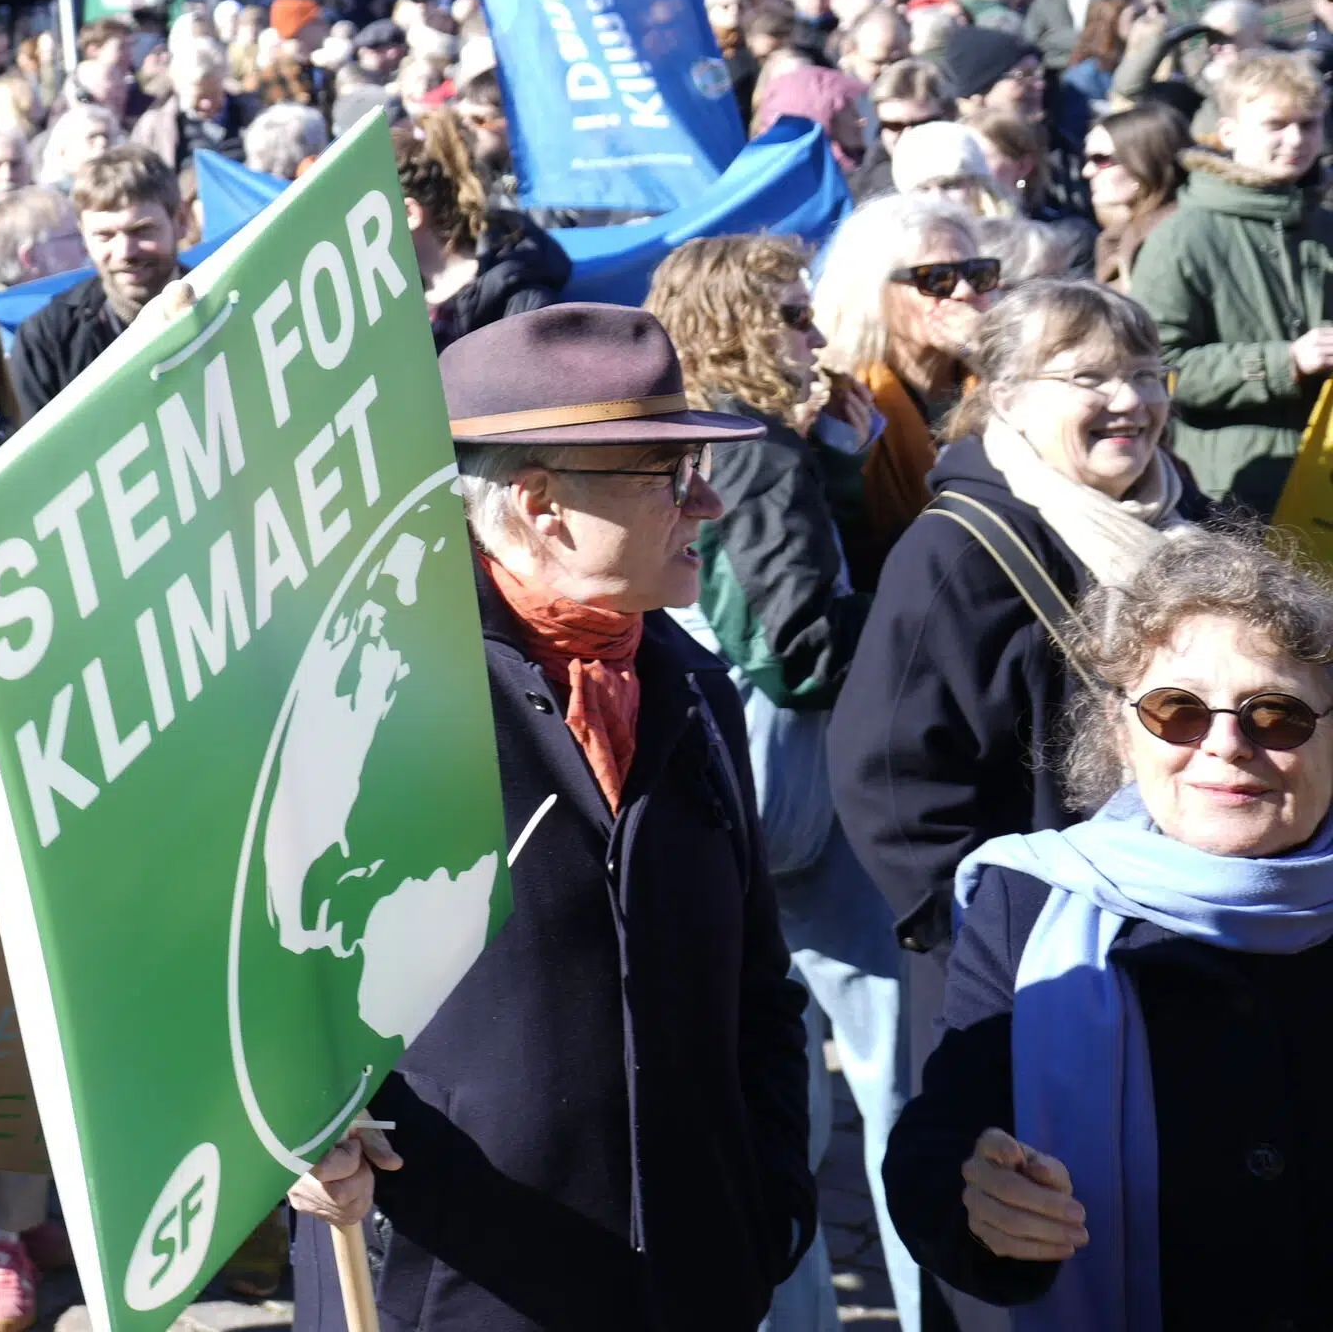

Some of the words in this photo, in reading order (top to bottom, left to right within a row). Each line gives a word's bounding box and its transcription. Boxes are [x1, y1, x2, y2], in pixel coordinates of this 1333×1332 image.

[252, 190, 407, 428] FOR
[15, 375, 382, 848] KLIMAET
[149, 1174, 206, 1291] SF
